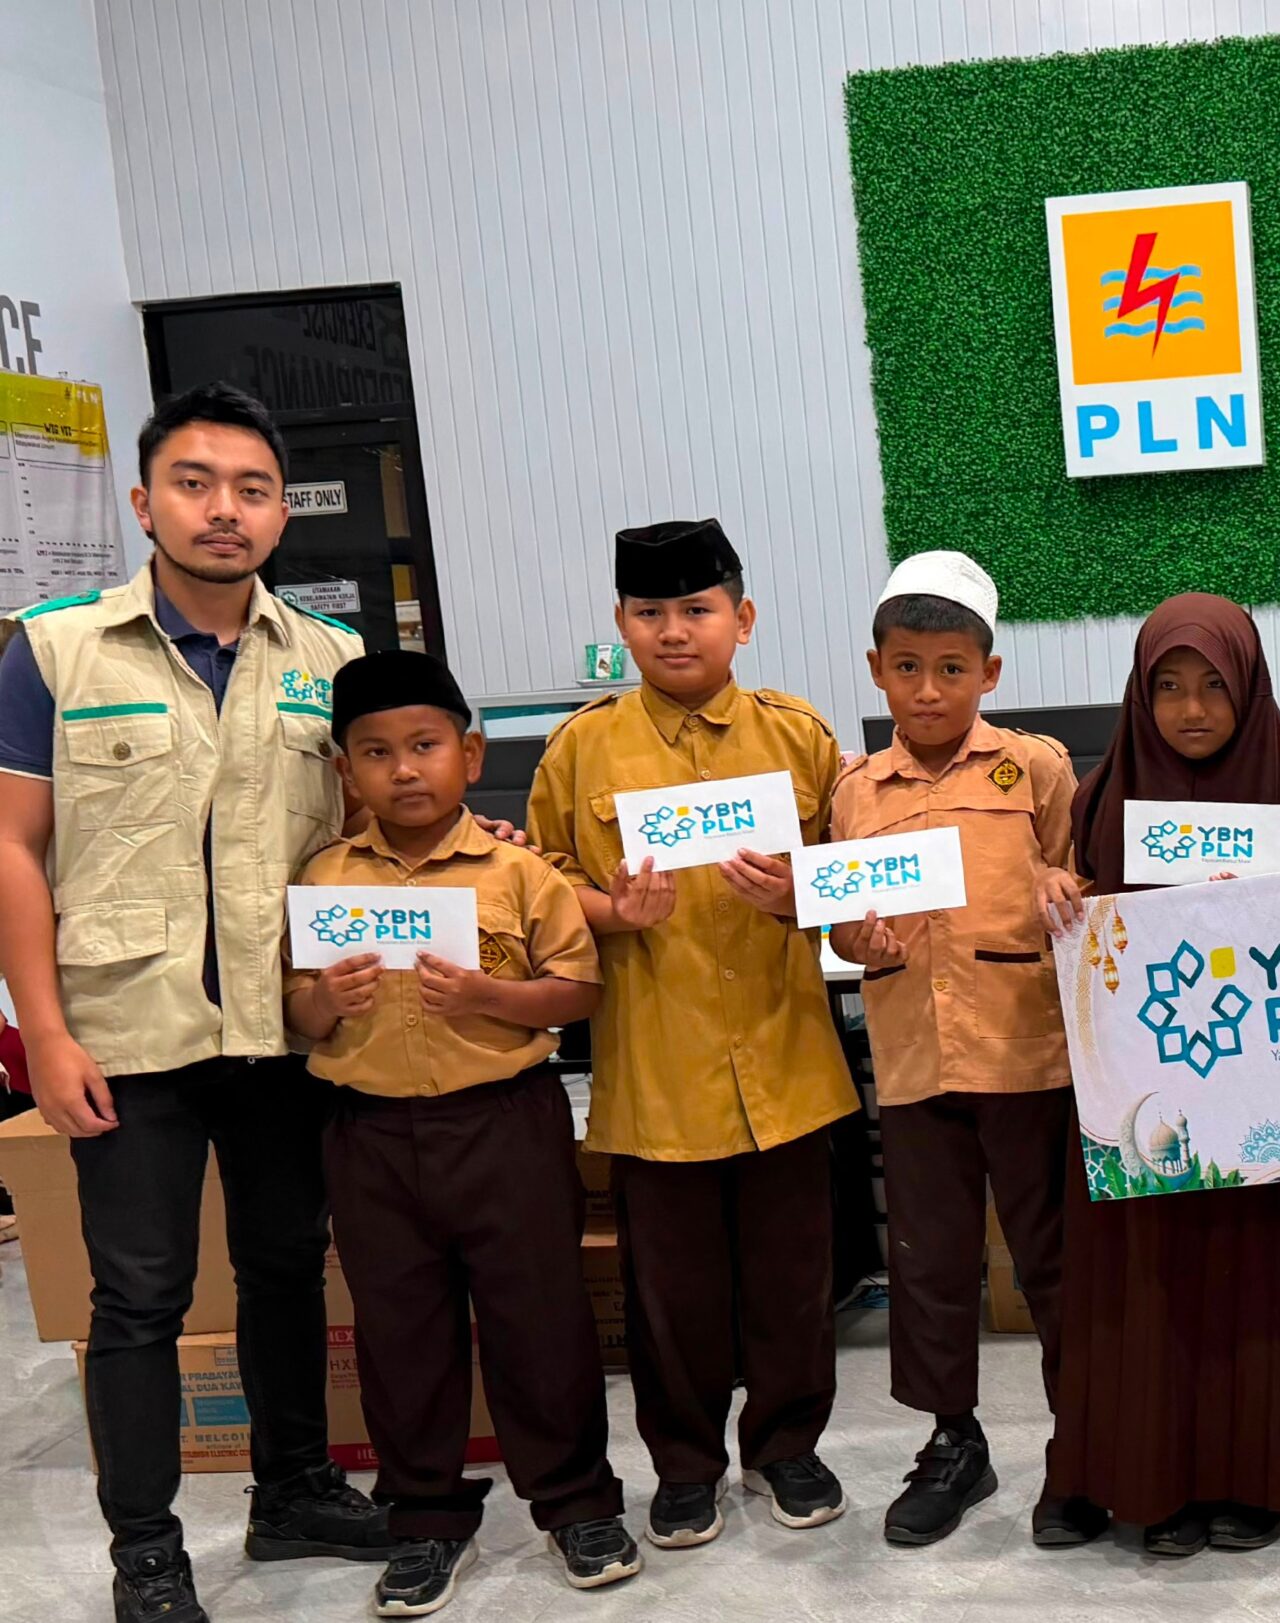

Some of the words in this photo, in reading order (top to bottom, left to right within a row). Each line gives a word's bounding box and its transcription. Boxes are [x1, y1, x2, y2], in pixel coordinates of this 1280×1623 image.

[1076, 393, 1247, 458] PLN
[314, 489, 342, 507] ONLY
[694, 798, 752, 819] YBM
[702, 813, 756, 834] PLN
[1197, 826, 1253, 842] YBM
[1201, 842, 1253, 858] PLN
[865, 853, 919, 873] YBM
[870, 868, 922, 888] PLN
[369, 908, 431, 924] YBM
[375, 925, 432, 940] PLN
[196, 1382, 219, 1392] DUA
